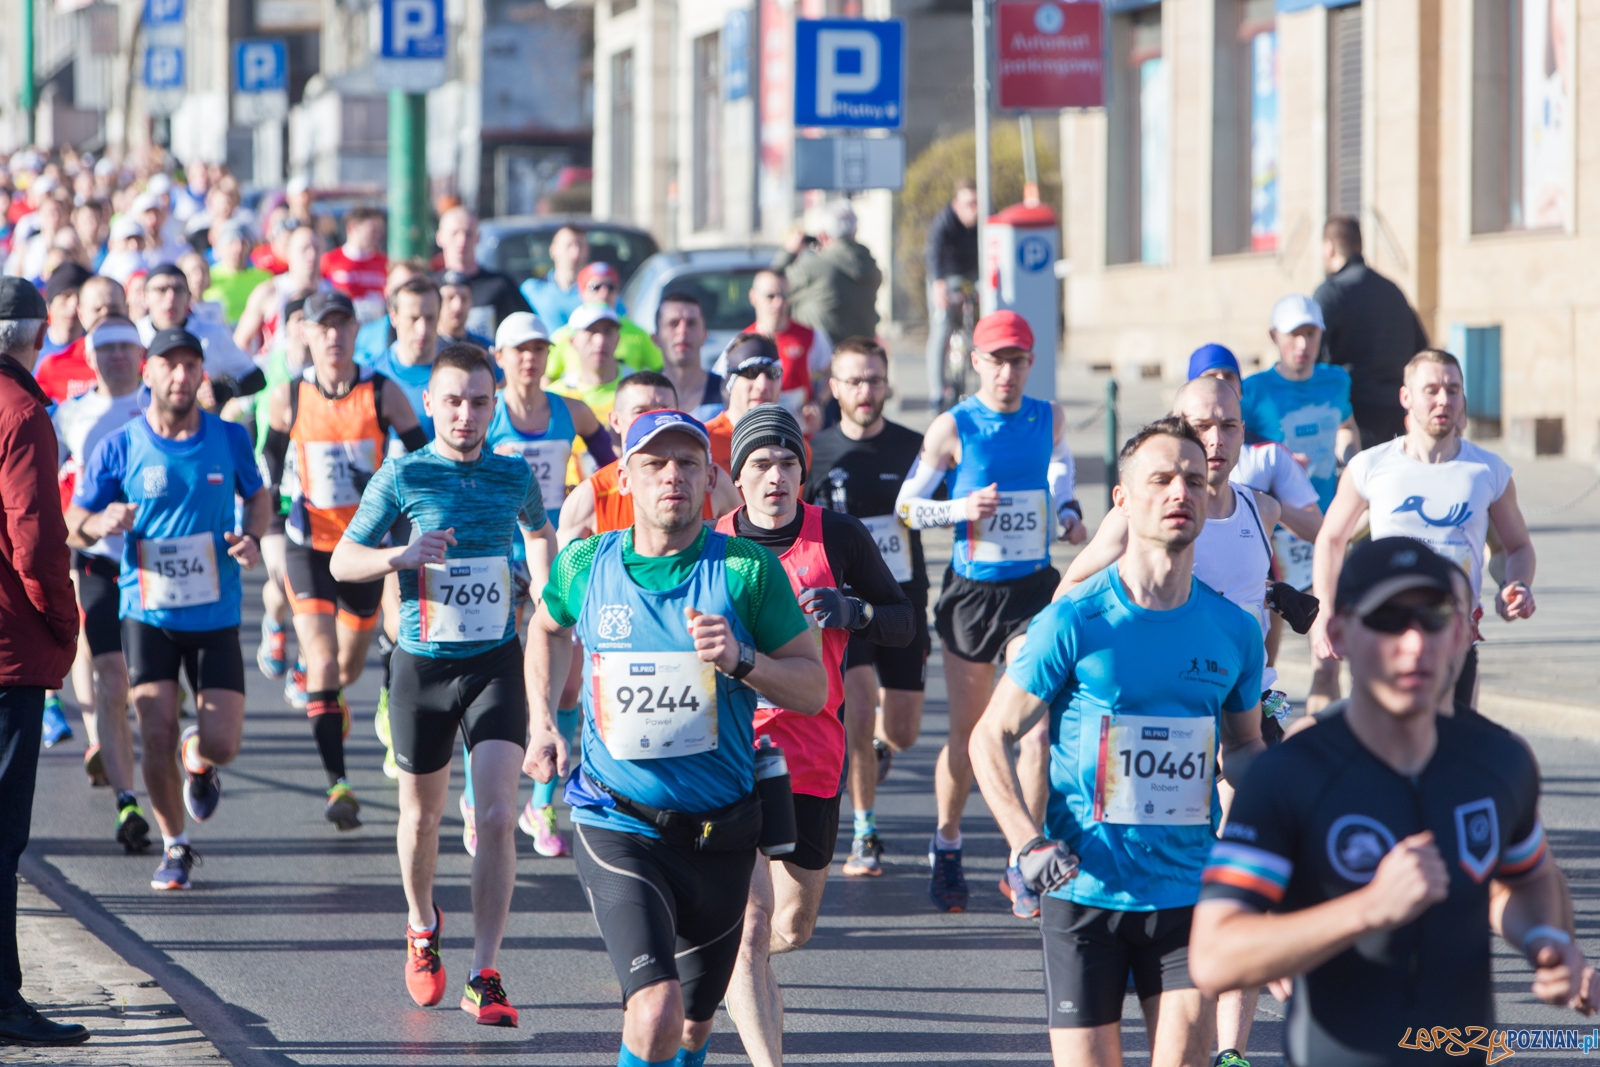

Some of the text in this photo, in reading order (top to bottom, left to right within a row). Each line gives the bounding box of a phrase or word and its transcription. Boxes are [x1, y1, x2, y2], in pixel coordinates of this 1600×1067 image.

[394, 0, 435, 53] P
[1010, 32, 1089, 51] Automat
[244, 42, 277, 86] P
[816, 29, 881, 118] P
[1001, 57, 1100, 78] parkingowy
[1023, 241, 1046, 268] P
[916, 505, 952, 518] DOLNY
[153, 556, 205, 579] 1534
[440, 582, 501, 606] 7696
[616, 685, 700, 714] 9244
[1119, 749, 1207, 780] 10461
[1150, 782, 1179, 792] Robert
